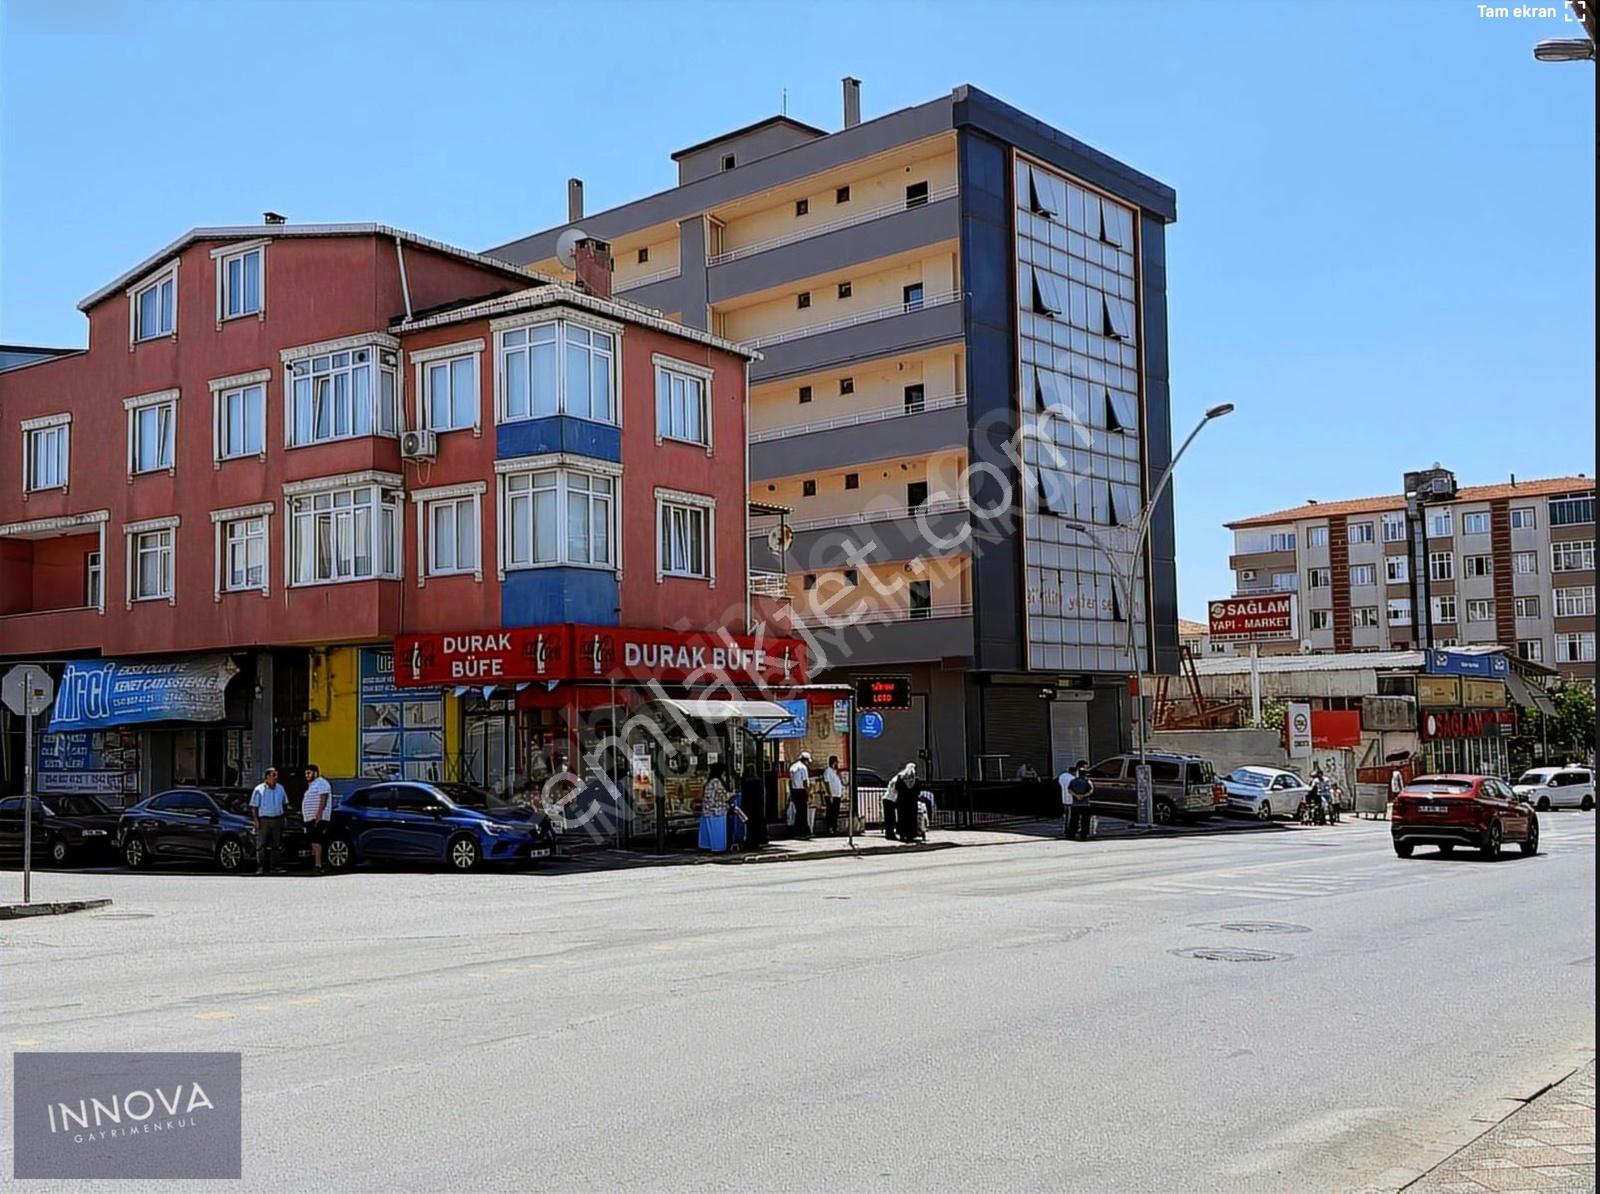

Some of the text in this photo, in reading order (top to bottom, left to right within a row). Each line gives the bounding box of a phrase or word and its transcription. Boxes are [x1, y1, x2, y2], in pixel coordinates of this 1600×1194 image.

[1227, 600, 1290, 616] SAĞLAM
[1211, 619, 1236, 631] YAPI
[1244, 616, 1290, 629] MARKET
[443, 633, 512, 654] DURAK
[452, 655, 504, 678] BÜFE
[624, 641, 767, 672] DURAK BÜFE
